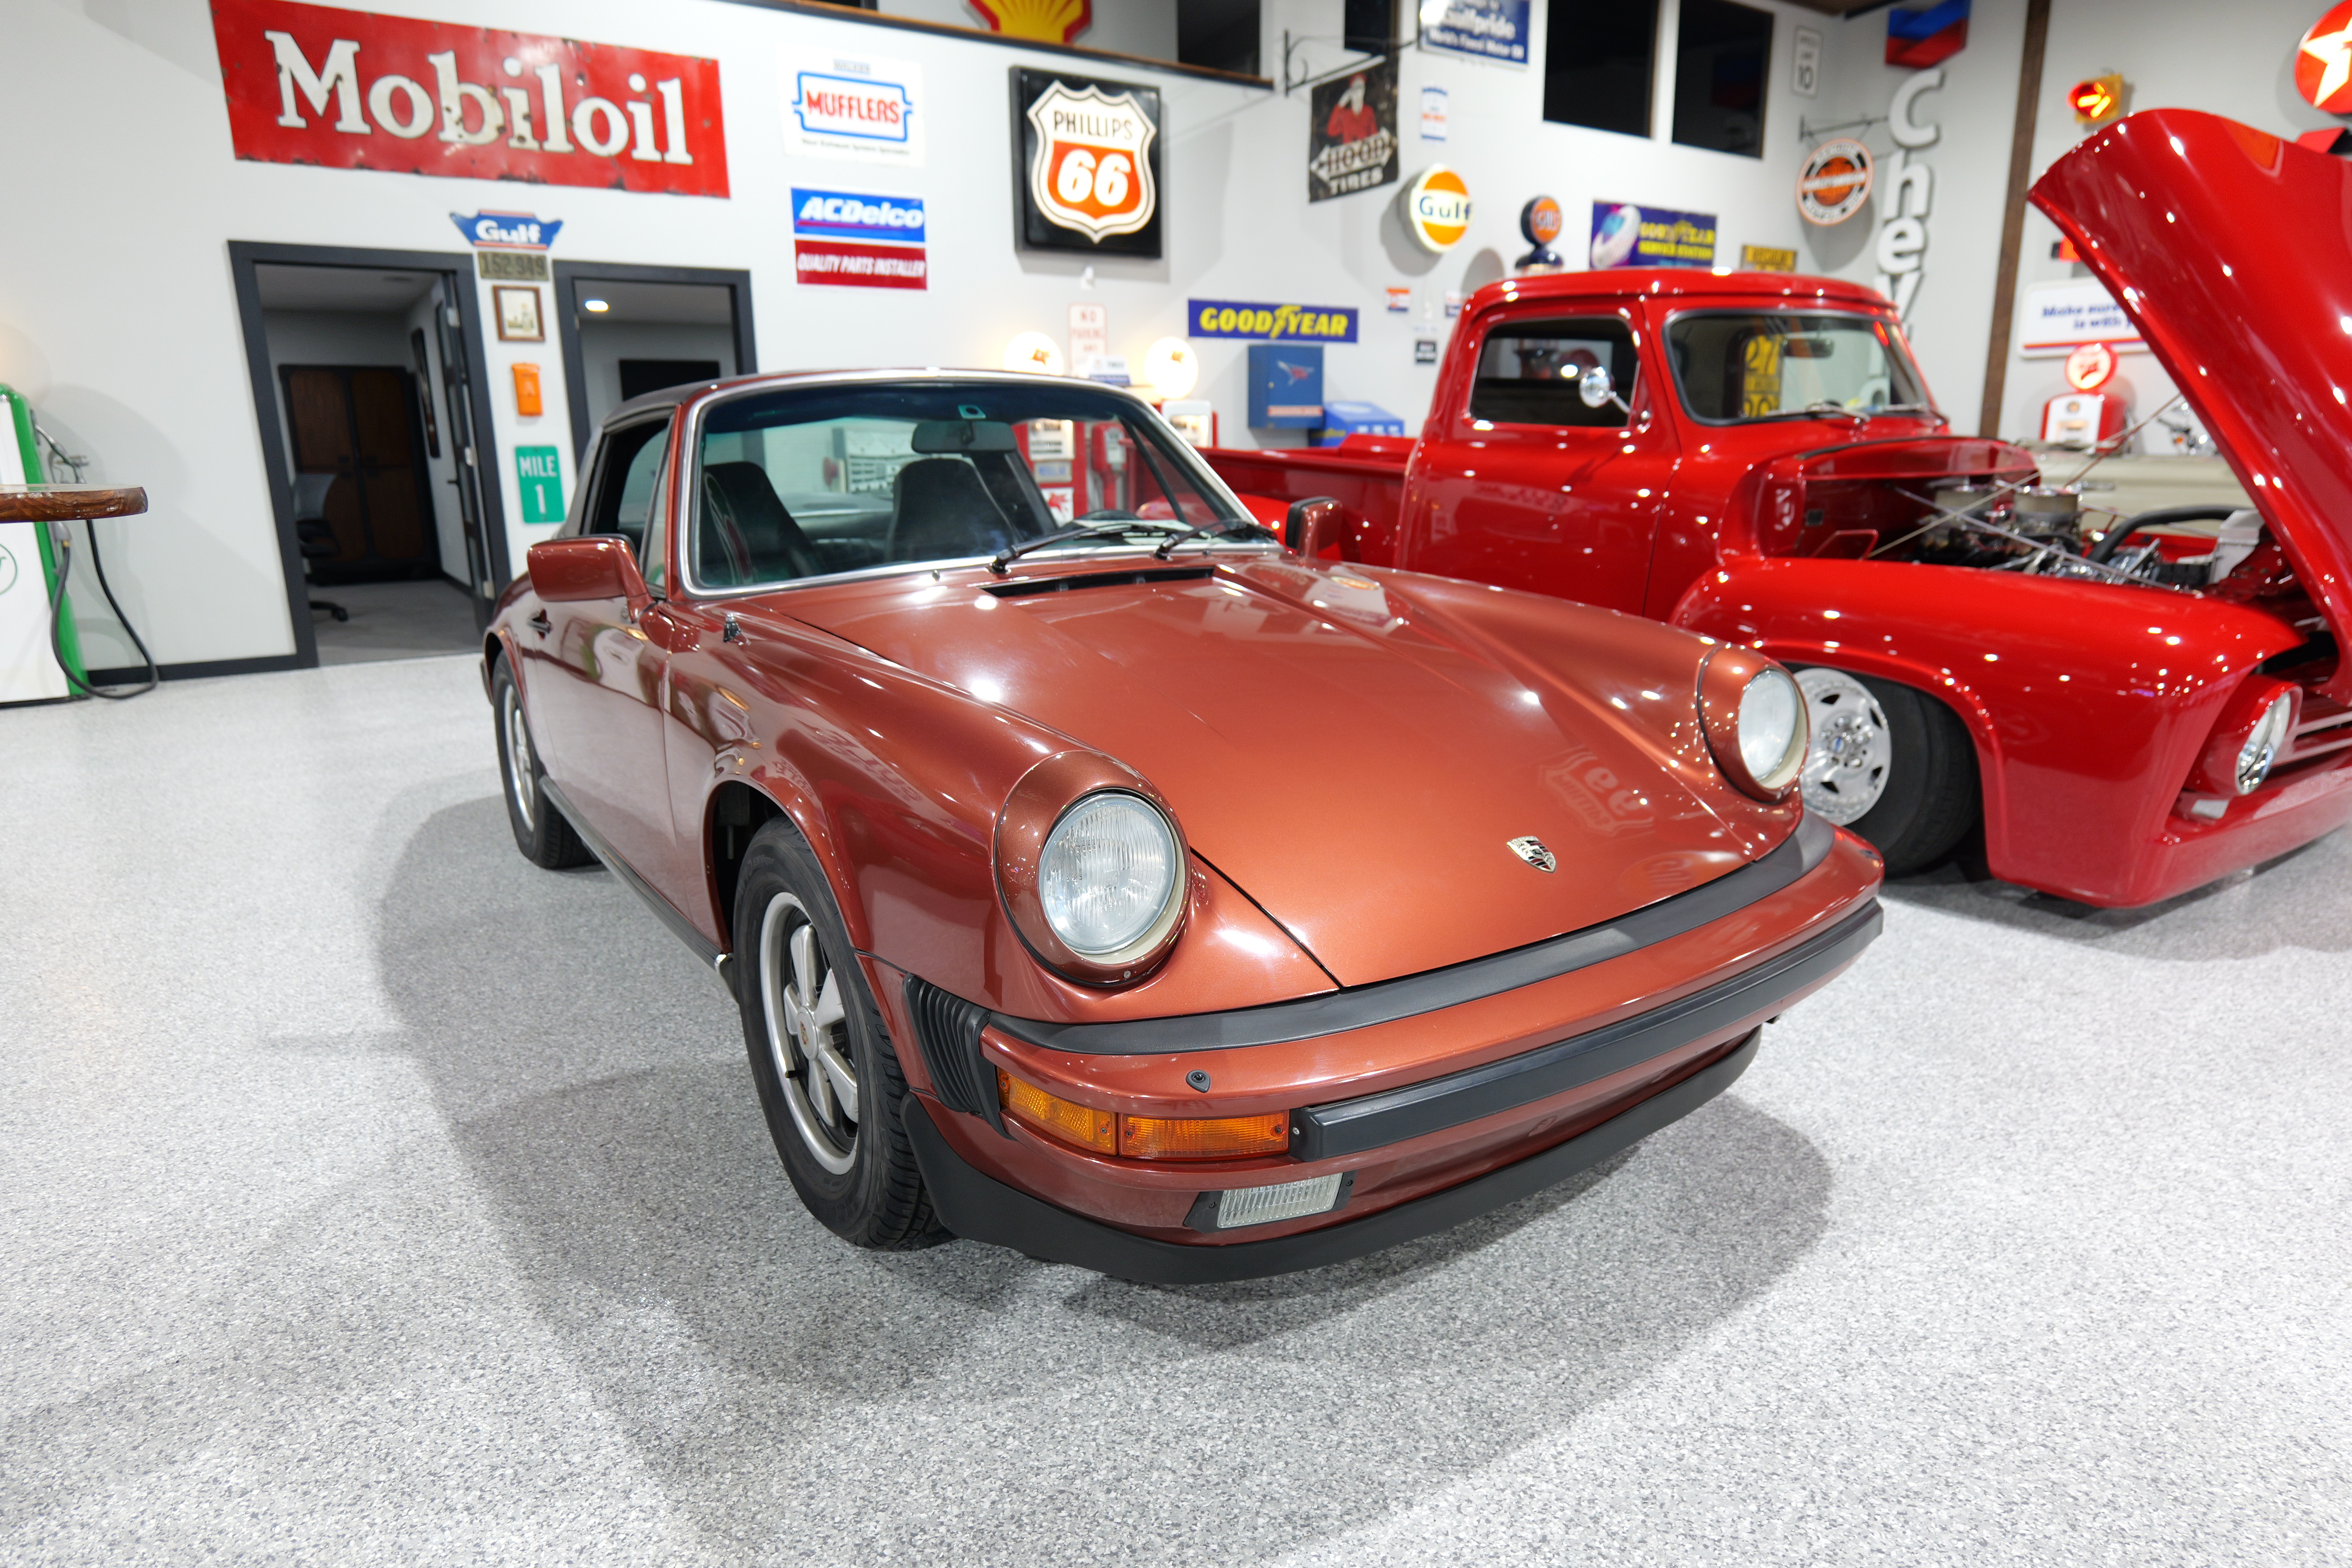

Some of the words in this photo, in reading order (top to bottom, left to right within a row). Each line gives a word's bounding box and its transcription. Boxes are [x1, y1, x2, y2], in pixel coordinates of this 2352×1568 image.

[264, 30, 694, 165] Mobiloil
[806, 90, 900, 124] MUFFLERS
[1053, 111, 1133, 141] PHILLIPS
[1327, 136, 1387, 173] HOOD
[1056, 149, 1132, 208] 66
[1330, 167, 1383, 195] TIRES
[799, 196, 924, 229] ACDelco
[1419, 196, 1473, 220] Gulf
[475, 219, 541, 243] Gulf
[797, 252, 842, 273] QUALITY
[840, 255, 875, 275] PARTS
[874, 257, 926, 278] INSTALLER
[1200, 304, 1348, 339] GOODYEAR
[518, 455, 557, 478] MILE
[534, 484, 547, 514] 1
